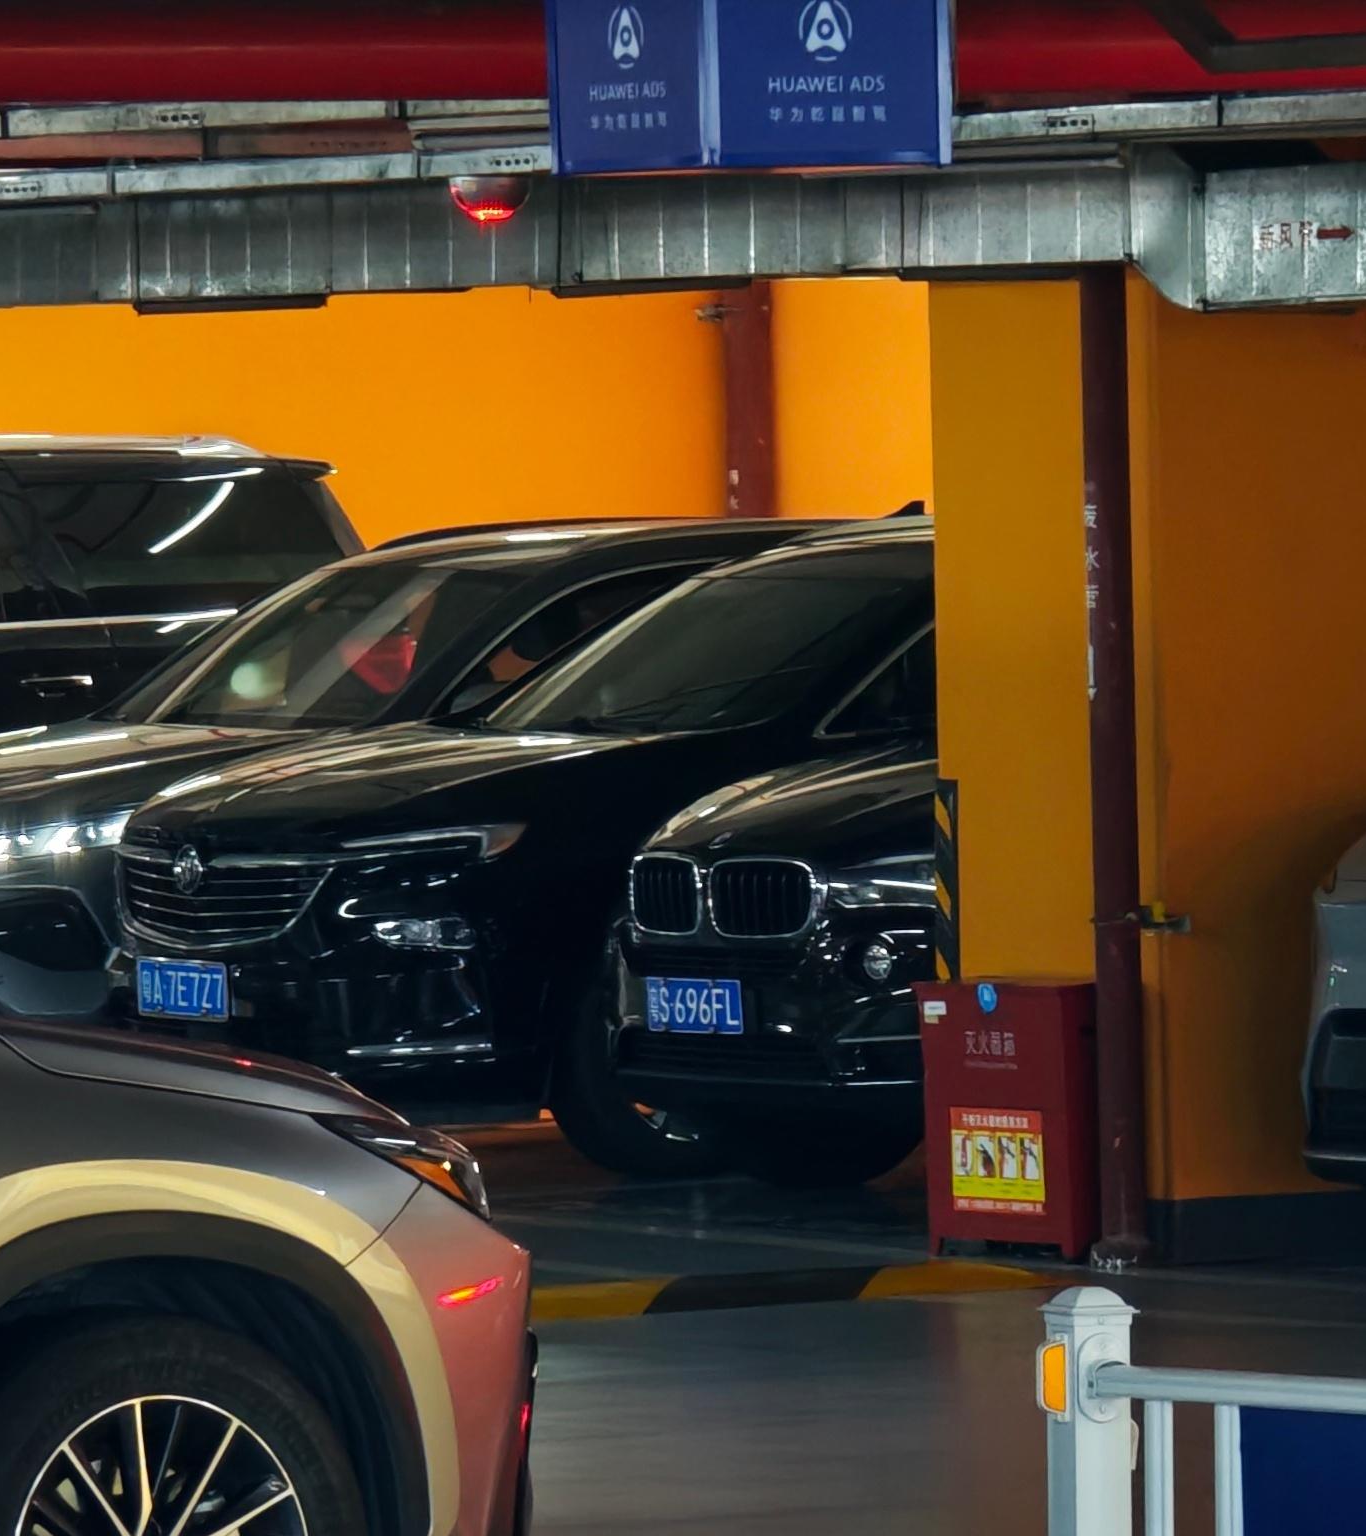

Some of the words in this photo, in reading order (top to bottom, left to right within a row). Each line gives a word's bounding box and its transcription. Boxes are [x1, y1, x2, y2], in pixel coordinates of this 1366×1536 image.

[588, 82, 639, 101] HUAWEI
[642, 80, 667, 98] ADS
[768, 75, 843, 93] HUAWEI
[850, 75, 886, 92] ADS
[963, 1031, 1015, 1056] 灭火器箱
